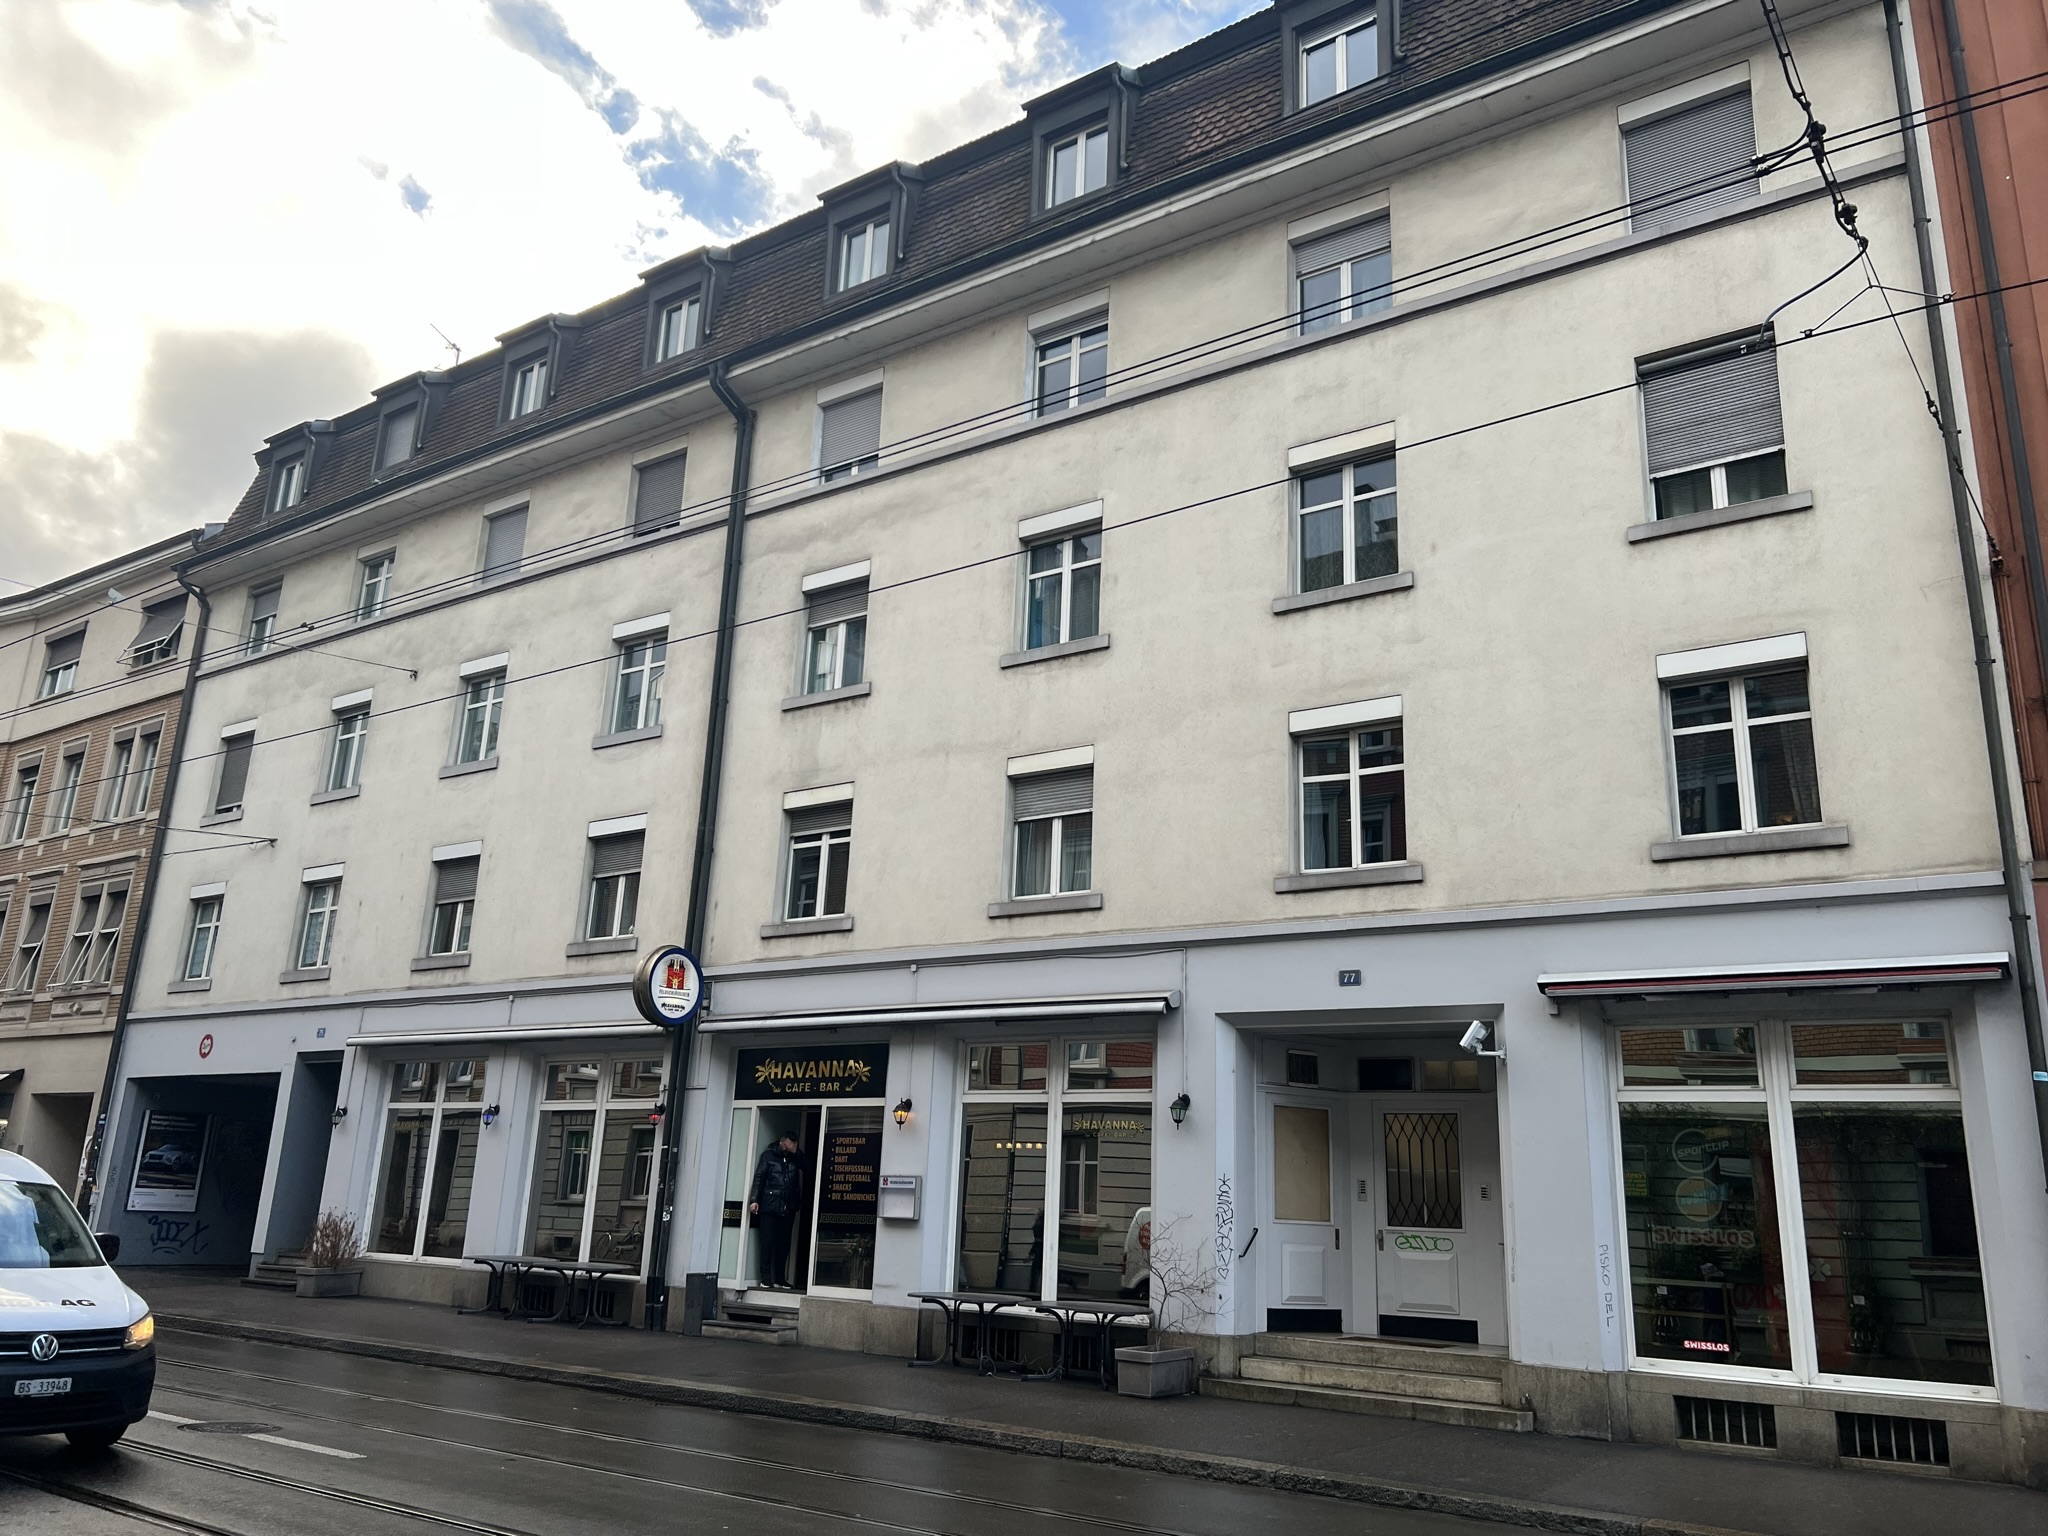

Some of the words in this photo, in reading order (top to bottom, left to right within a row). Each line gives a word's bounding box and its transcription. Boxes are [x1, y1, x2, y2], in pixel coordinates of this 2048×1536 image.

[1343, 973, 1356, 983] 77
[770, 1059, 857, 1079] HAVANNA
[785, 1083, 811, 1093] CAFE
[820, 1082, 840, 1092] BAR
[1082, 1120, 1137, 1130] HAVANNA
[836, 1137, 866, 1145] SPORTSBAR
[835, 1146, 857, 1154] BILLARD
[834, 1155, 848, 1163] DART
[834, 1165, 873, 1173] TISCHFUSSBALL
[833, 1174, 845, 1182] LIVE
[845, 1174, 871, 1182] FUSSBALL
[832, 1183, 852, 1191] SNACKS
[843, 1192, 876, 1201] SANDWICHES
[1653, 1226, 1754, 1248] SWISSLOS
[61, 1299, 96, 1307] AG
[1683, 1340, 1730, 1352] SWISSLOS
